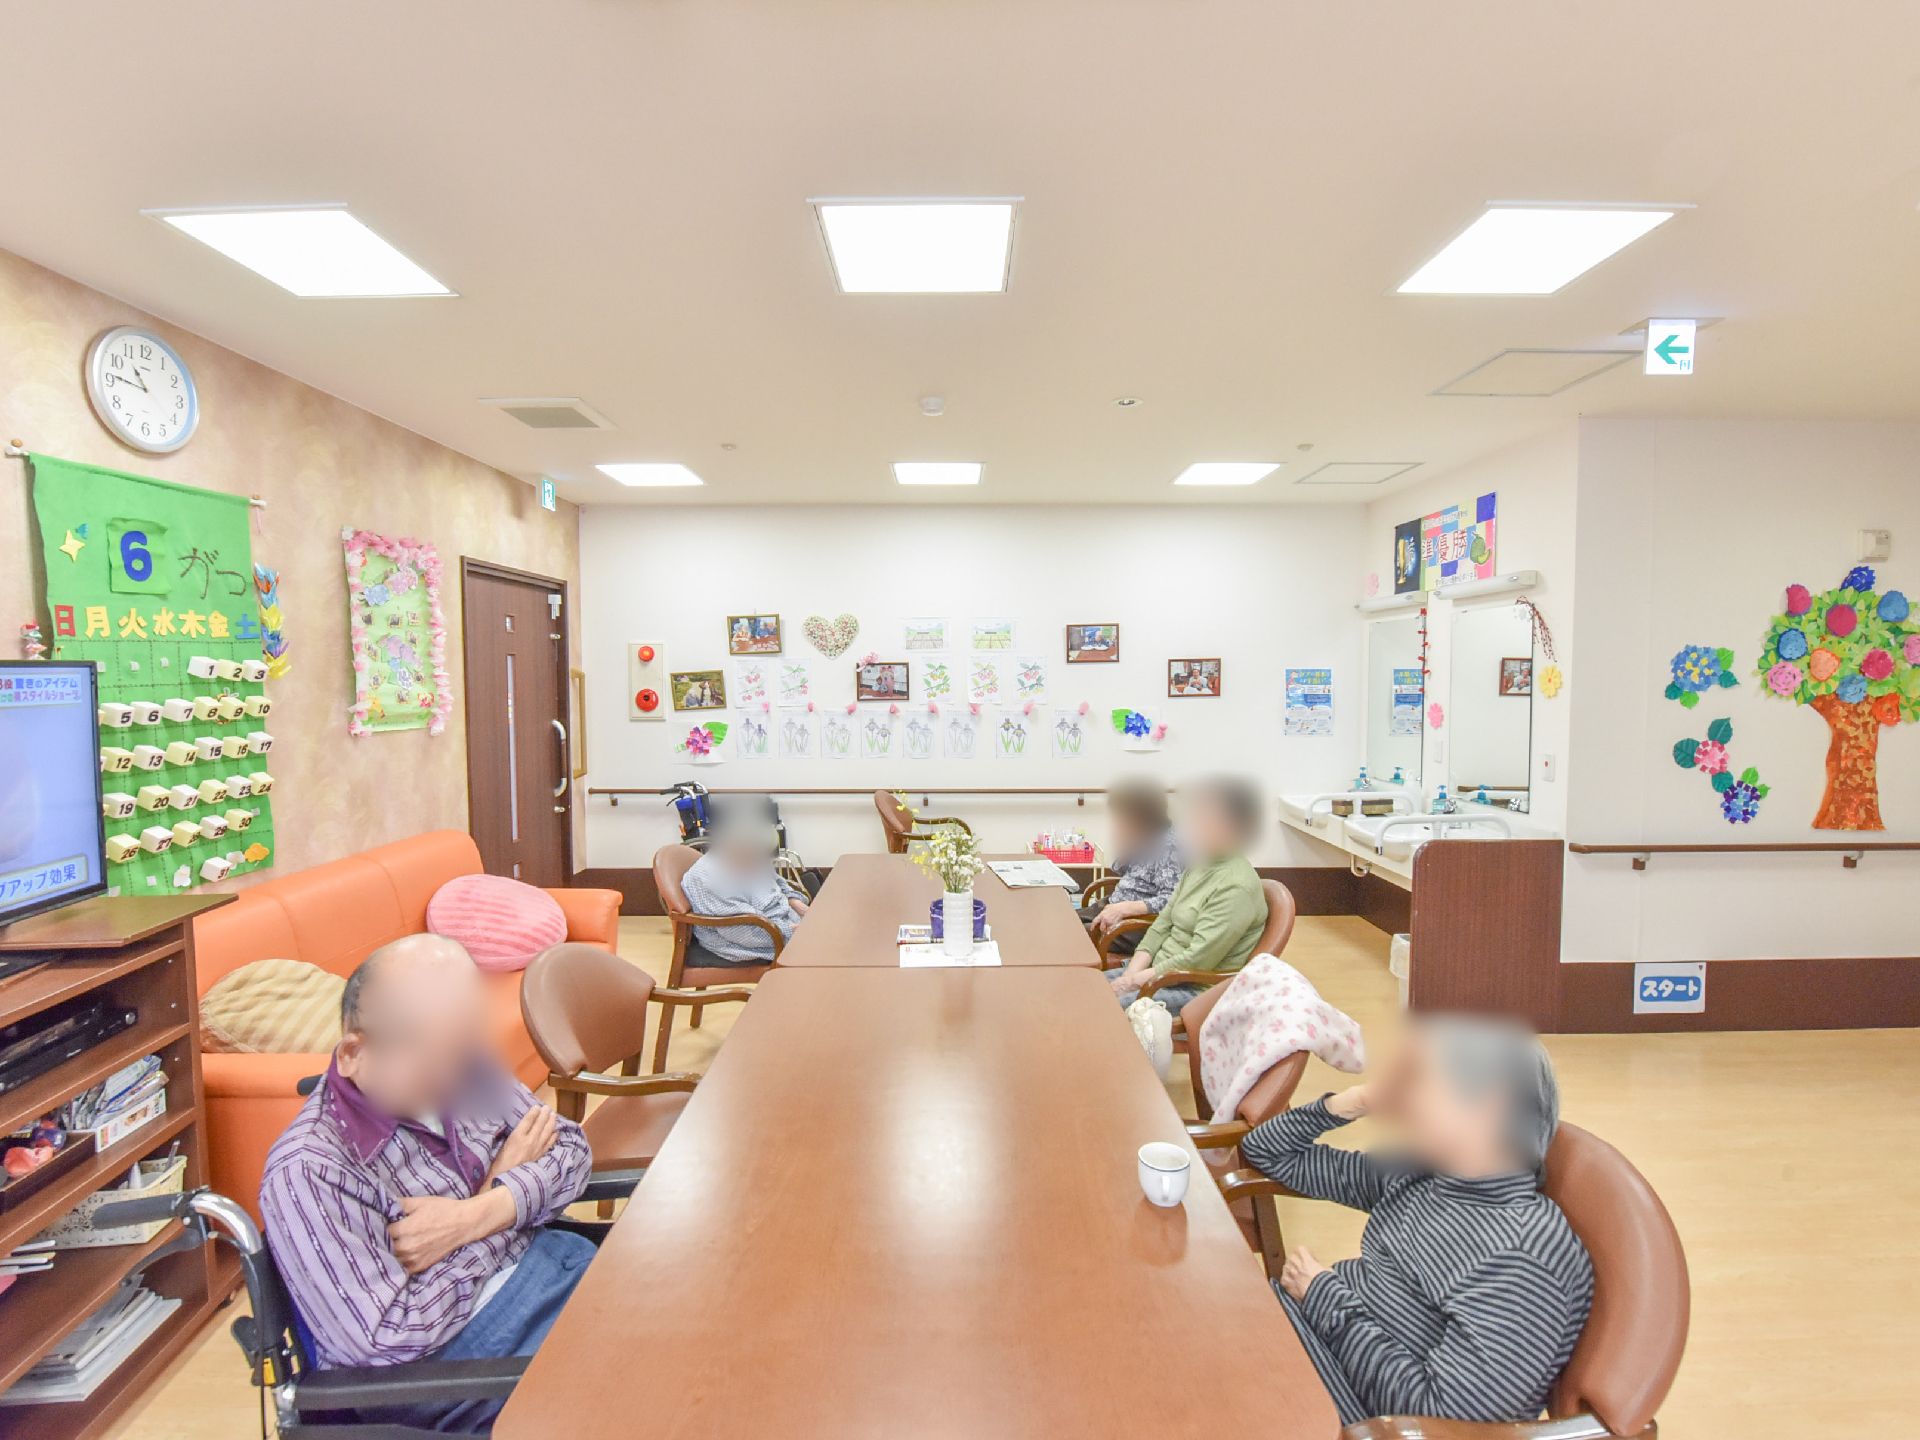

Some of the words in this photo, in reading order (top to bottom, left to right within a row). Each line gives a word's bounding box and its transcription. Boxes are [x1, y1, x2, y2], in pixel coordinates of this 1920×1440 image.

[124, 343, 134, 360] 11
[140, 344, 152, 361] 12
[111, 353, 124, 370] 10
[160, 357, 165, 371] 1
[105, 372, 115, 388] 9
[170, 374, 178, 389] 2
[112, 395, 121, 409] 8
[175, 394, 184, 409] 3
[125, 412, 134, 427] 7
[169, 413, 177, 425] 4
[141, 422, 150, 437] 6
[159, 424, 167, 437] 5
[120, 530, 153, 582] 6
[178, 547, 247, 600] がつ
[208, 665, 215, 676] 1
[233, 667, 242, 678] 2
[254, 670, 265, 680] 3
[120, 711, 132, 724] 5
[149, 710, 159, 722] 6
[183, 708, 193, 719] 7
[207, 708, 218, 718] 8
[233, 707, 244, 717] 9
[258, 704, 271, 714] 10
[116, 757, 131, 769] 12
[149, 755, 163, 767] 13
[184, 751, 196, 763] 14
[210, 746, 222, 757] 15
[237, 744, 248, 755] 16
[260, 741, 272, 751] 17
[119, 803, 134, 815] 19
[152, 796, 170, 808] 20
[184, 795, 198, 807] 21
[212, 789, 227, 801] 22
[238, 785, 252, 796] 23
[257, 783, 272, 793] 24
[121, 846, 137, 860] 26
[156, 837, 172, 850] 27
[238, 817, 252, 829] 30
[217, 867, 230, 880] 31
[1642, 979, 1698, 998] スタート
